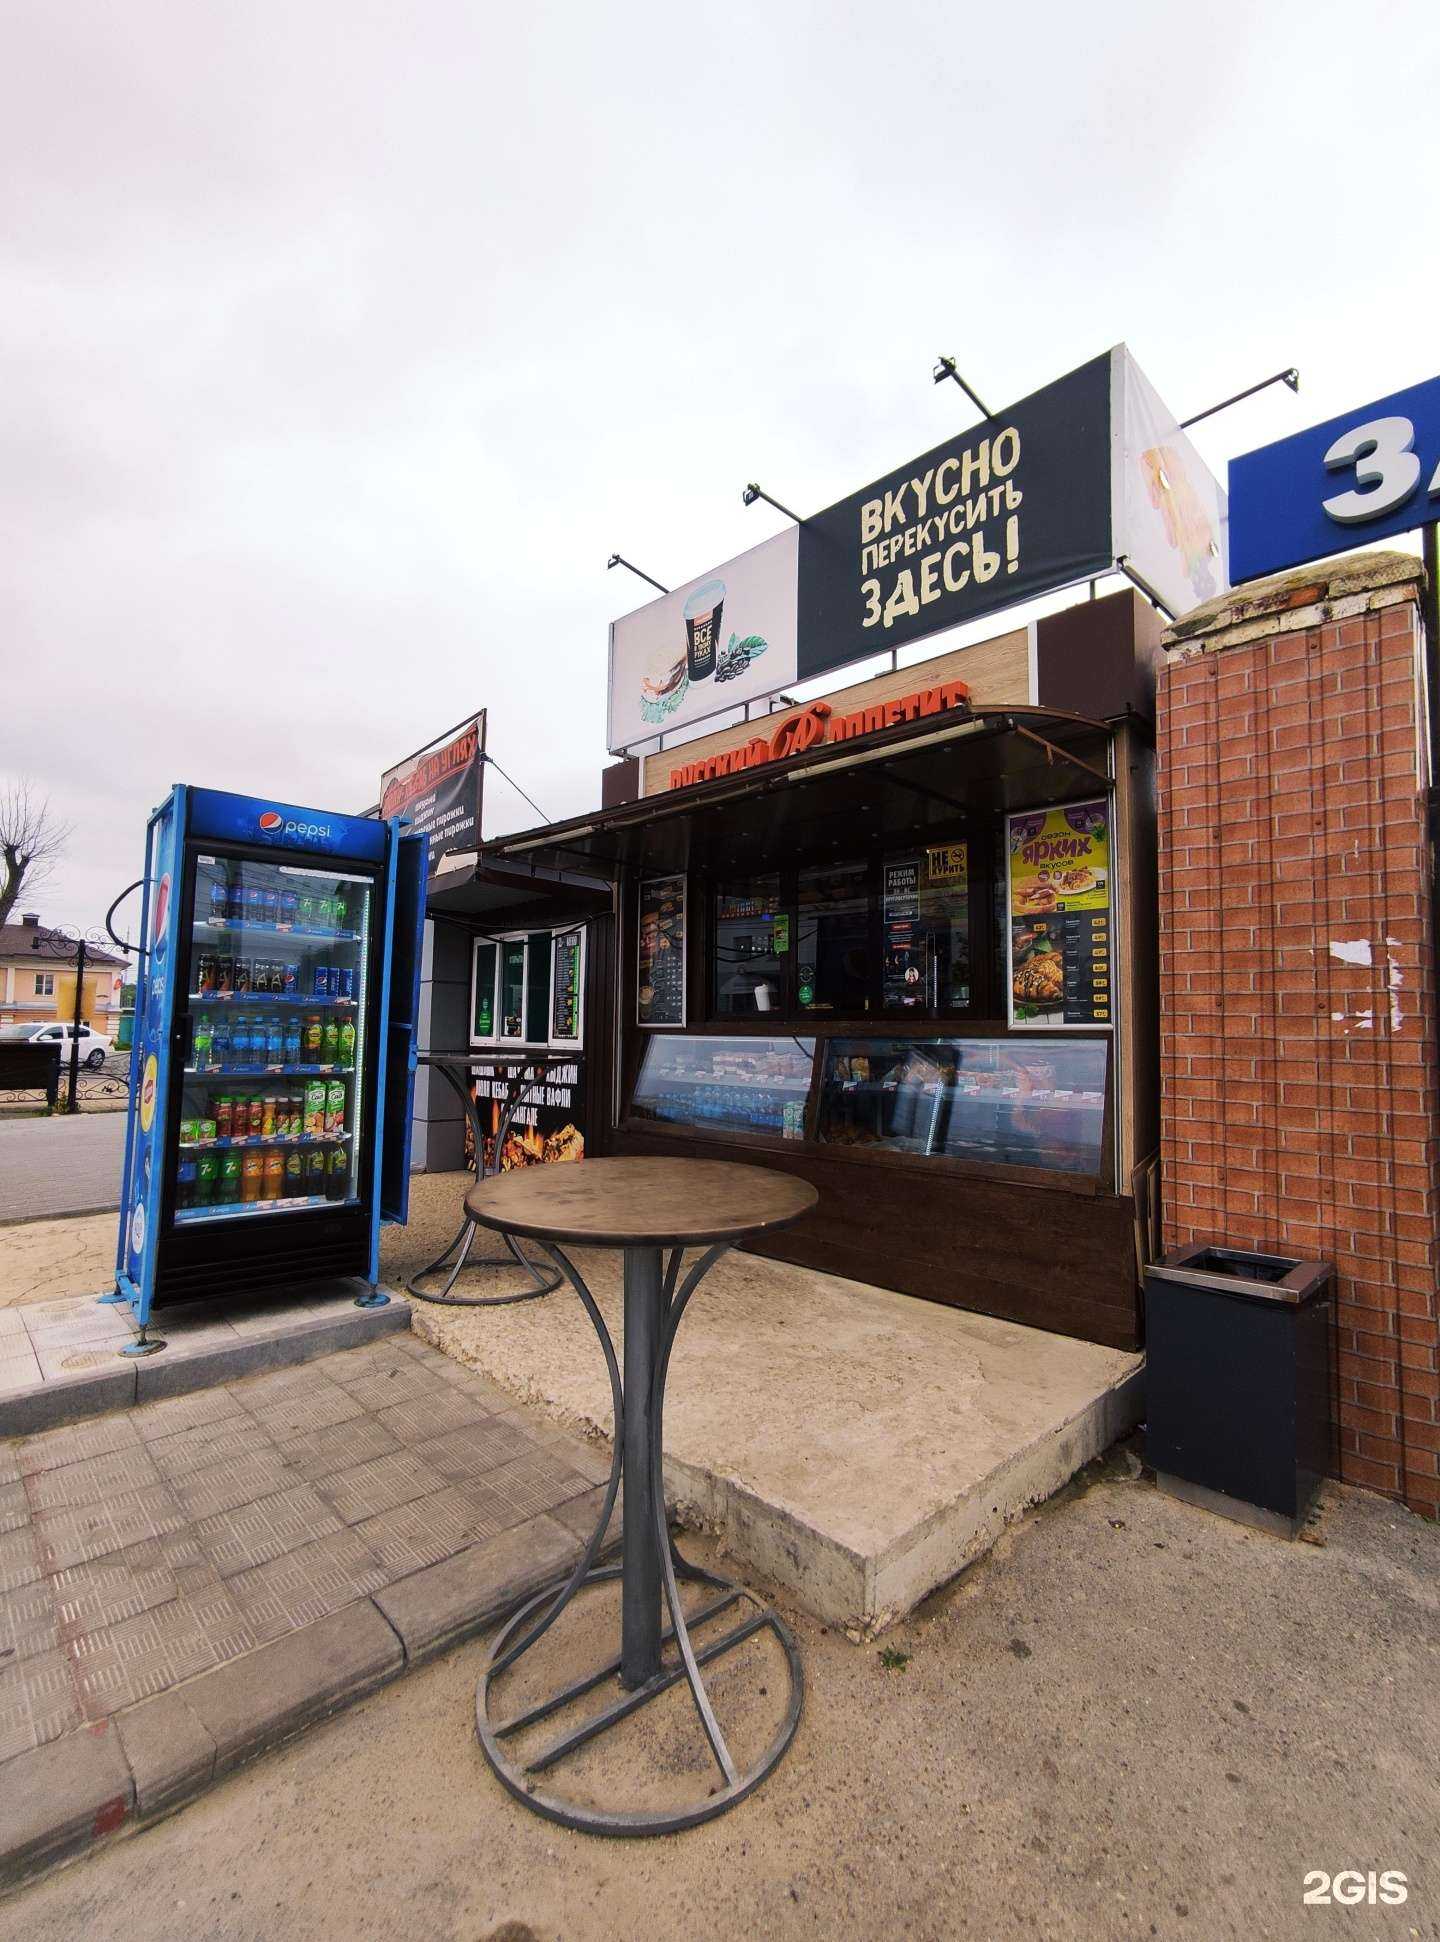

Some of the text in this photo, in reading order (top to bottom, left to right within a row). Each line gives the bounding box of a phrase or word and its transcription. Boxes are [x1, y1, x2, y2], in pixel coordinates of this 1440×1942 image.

[1321, 416, 1440, 524] З
[861, 427, 1021, 544] ВКУСНО
[862, 479, 1023, 576] ПЕРЕКУСИТЬ
[861, 515, 1020, 628] ЗДЕСЬ!
[285, 820, 331, 838] pepsi
[436, 805, 465, 829] пирожки
[444, 817, 474, 837] пирожки
[888, 876, 916, 887] РАБОТЫ
[546, 1087, 571, 1109] ВАФЛИ
